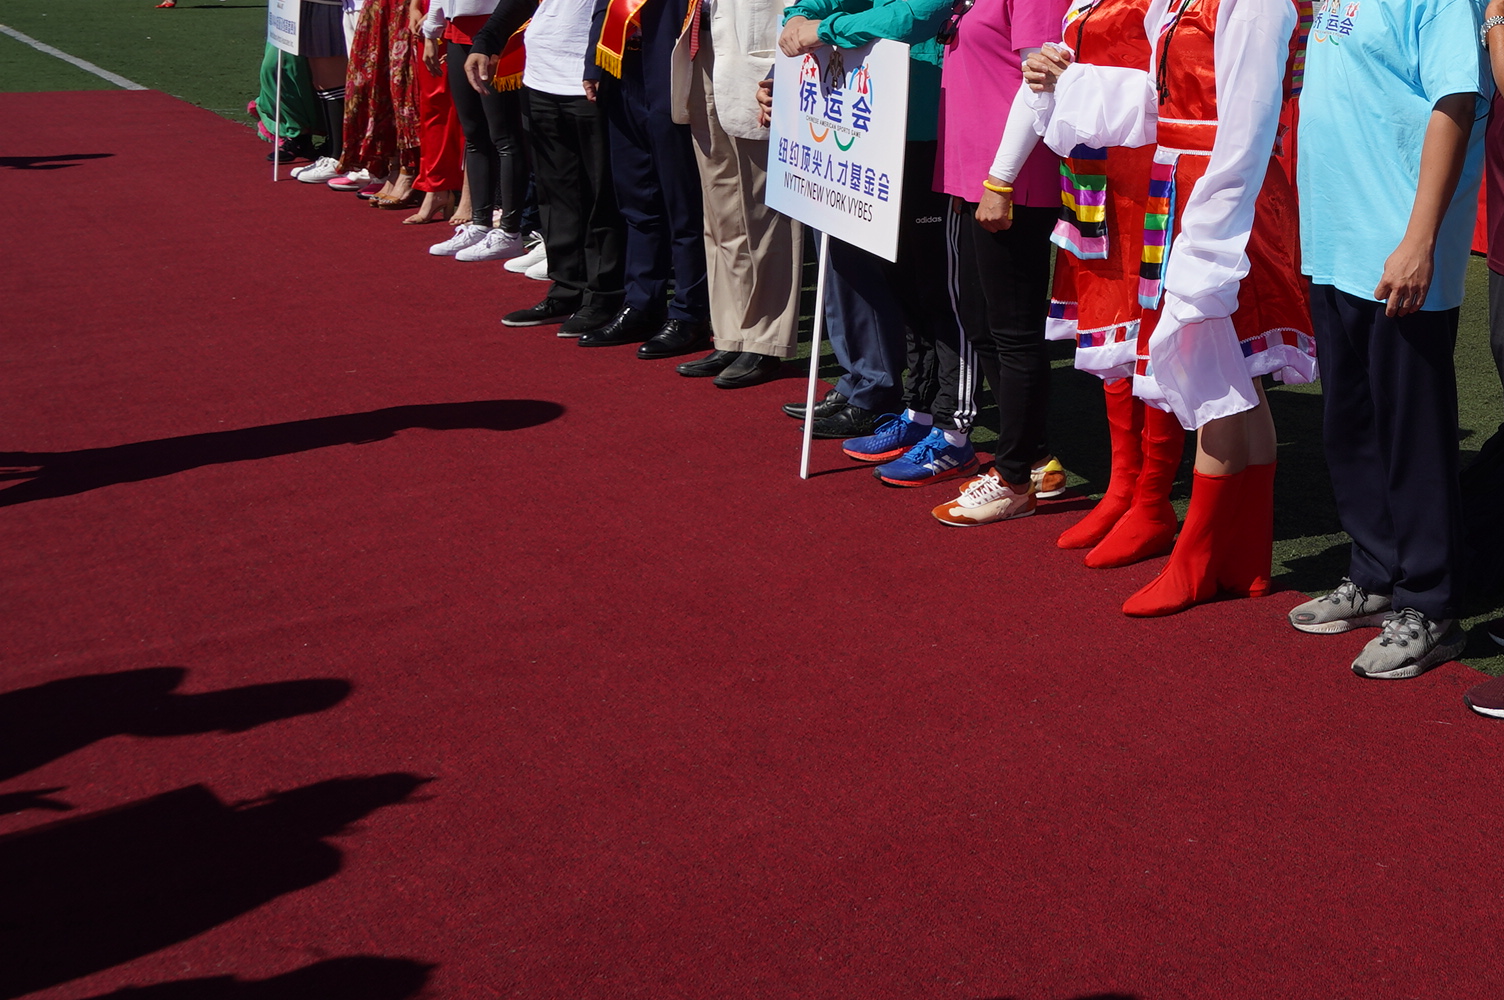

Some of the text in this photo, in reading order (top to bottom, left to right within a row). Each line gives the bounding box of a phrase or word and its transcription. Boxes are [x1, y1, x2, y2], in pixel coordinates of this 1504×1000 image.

[799, 80, 872, 132] 侨运会
[806, 115, 861, 139] CHINESE AMERICAN SPORTS GAME
[778, 137, 890, 202] 纽约顶尖人才基金会
[826, 187, 846, 213] YORK
[848, 196, 873, 222] VYBES
[915, 216, 942, 224] adidas
